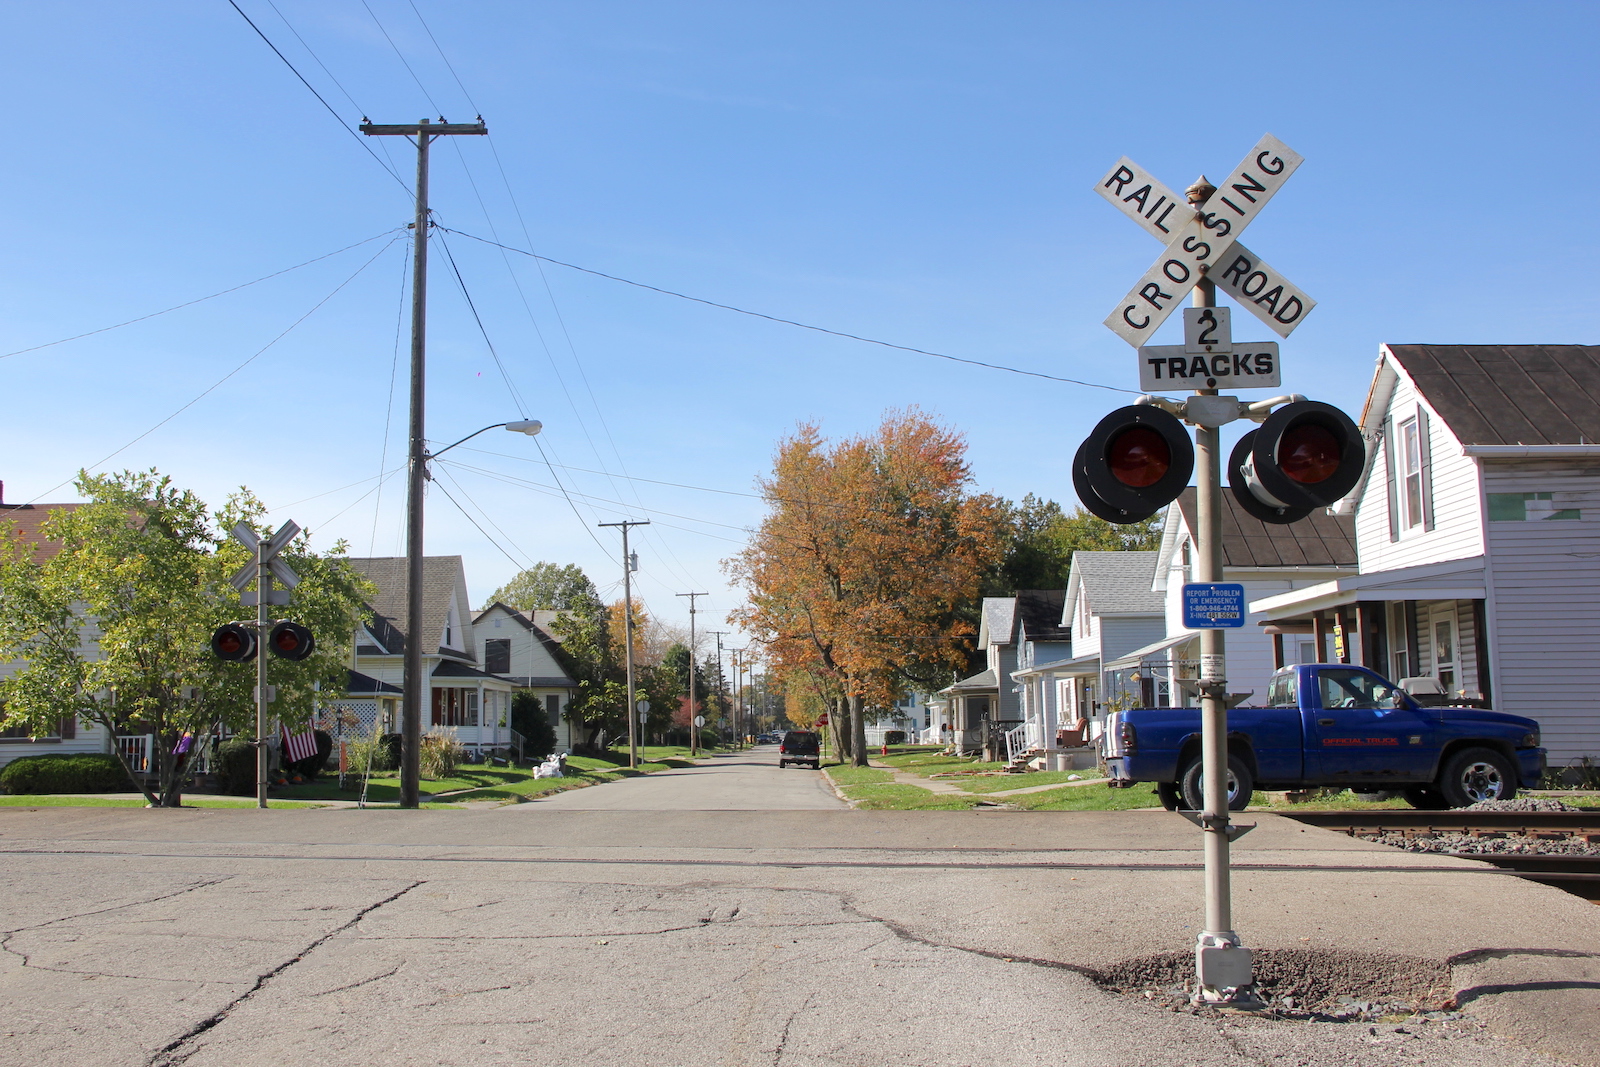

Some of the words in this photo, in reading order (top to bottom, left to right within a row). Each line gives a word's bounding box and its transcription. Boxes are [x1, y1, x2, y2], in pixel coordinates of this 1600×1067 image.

[1104, 164, 1176, 234] RAIL
[1222, 255, 1303, 325] ROAD
[1123, 150, 1285, 330] CROSSING
[1148, 353, 1273, 379] TRACKS
[1197, 312, 1219, 345] 2
